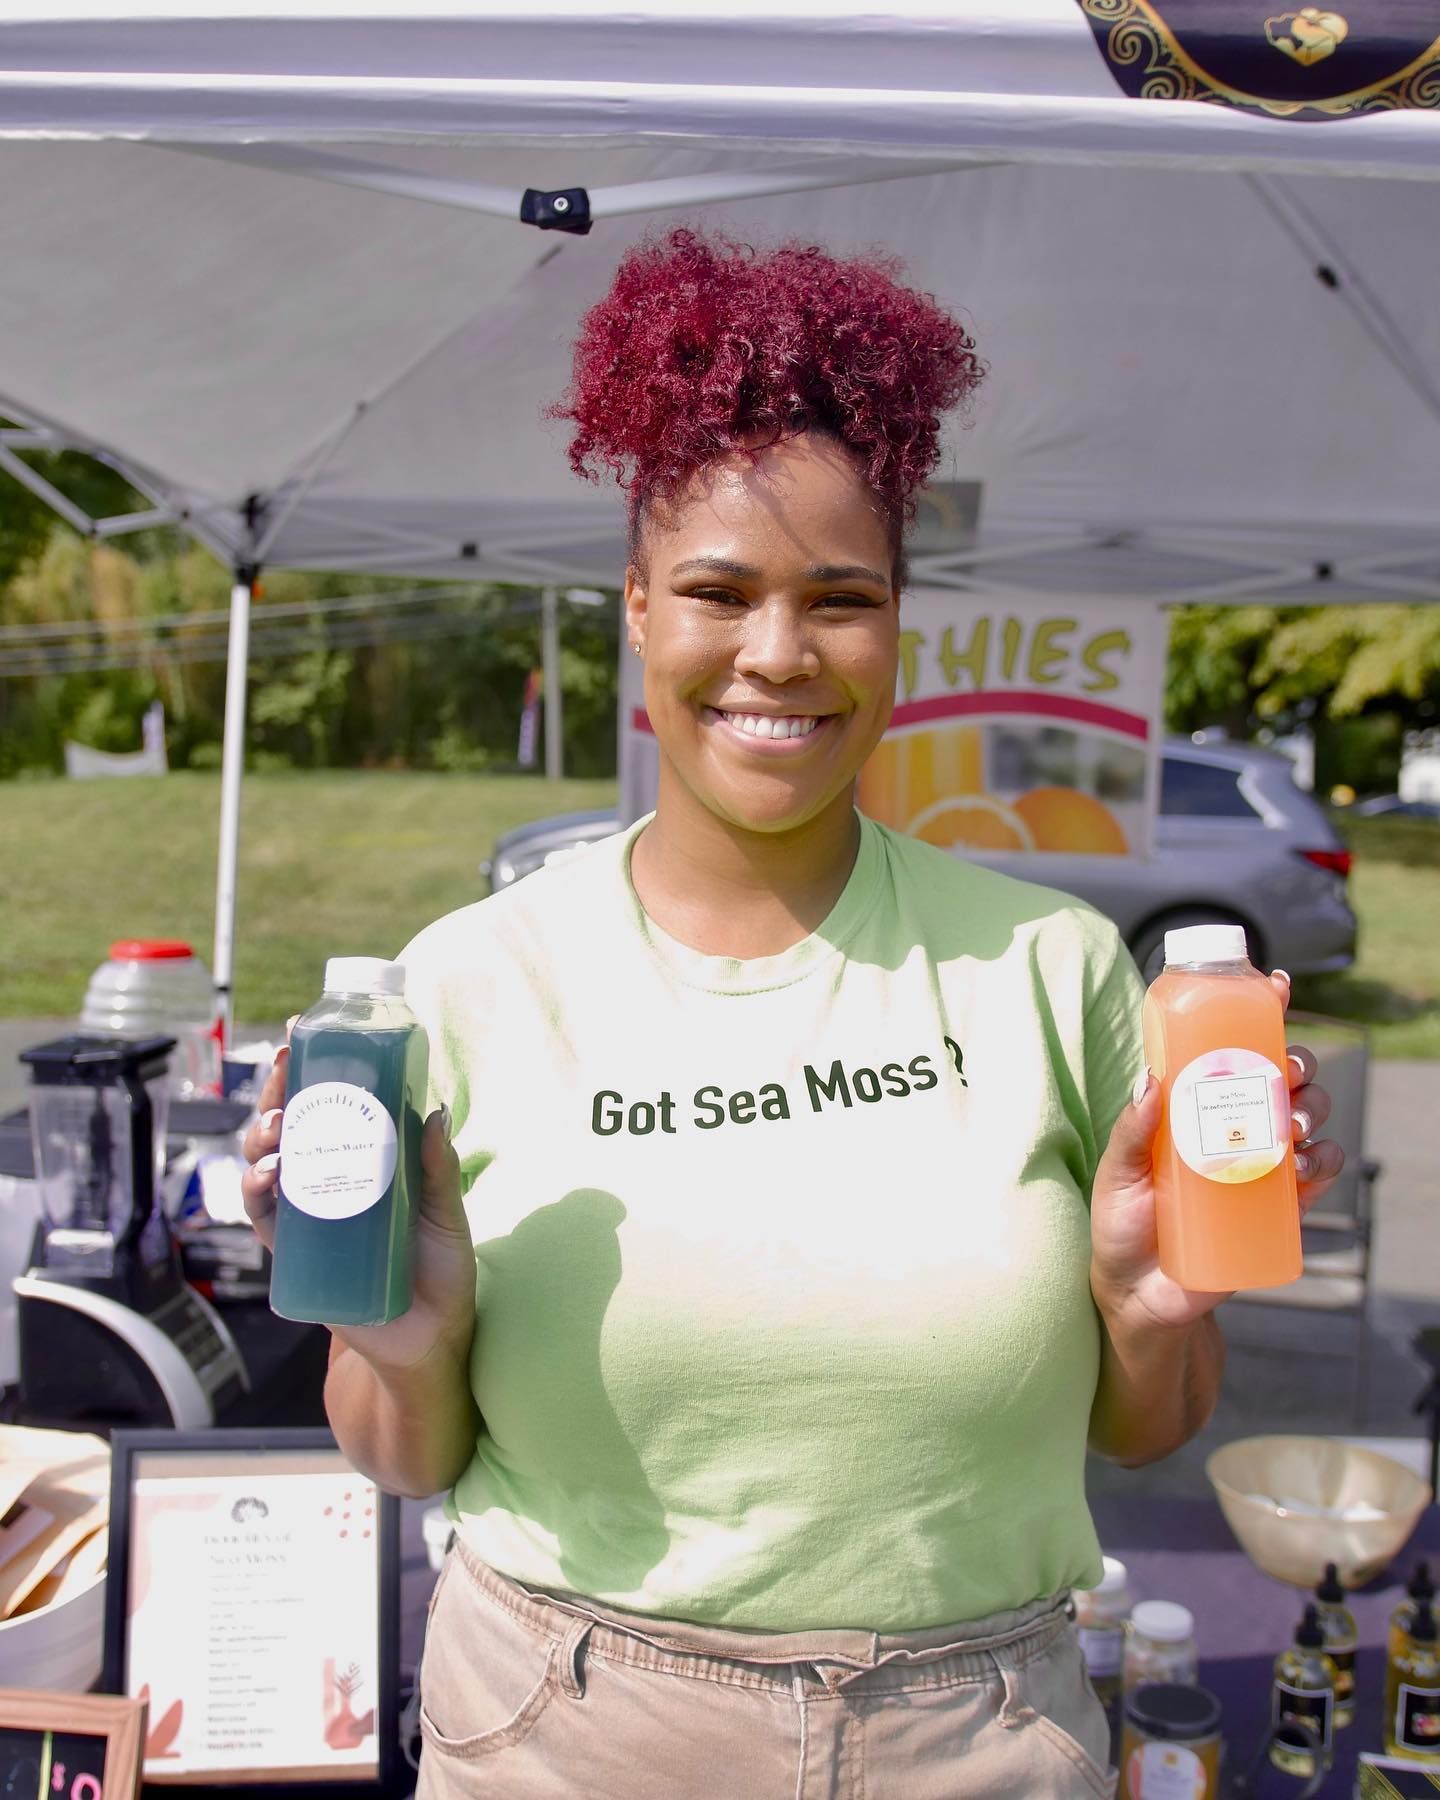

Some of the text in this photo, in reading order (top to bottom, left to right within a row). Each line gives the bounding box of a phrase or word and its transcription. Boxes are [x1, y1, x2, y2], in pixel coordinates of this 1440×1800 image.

[591, 1089, 677, 1136] Got
[693, 1083, 791, 1130] Sea
[803, 1055, 939, 1113] Moss
